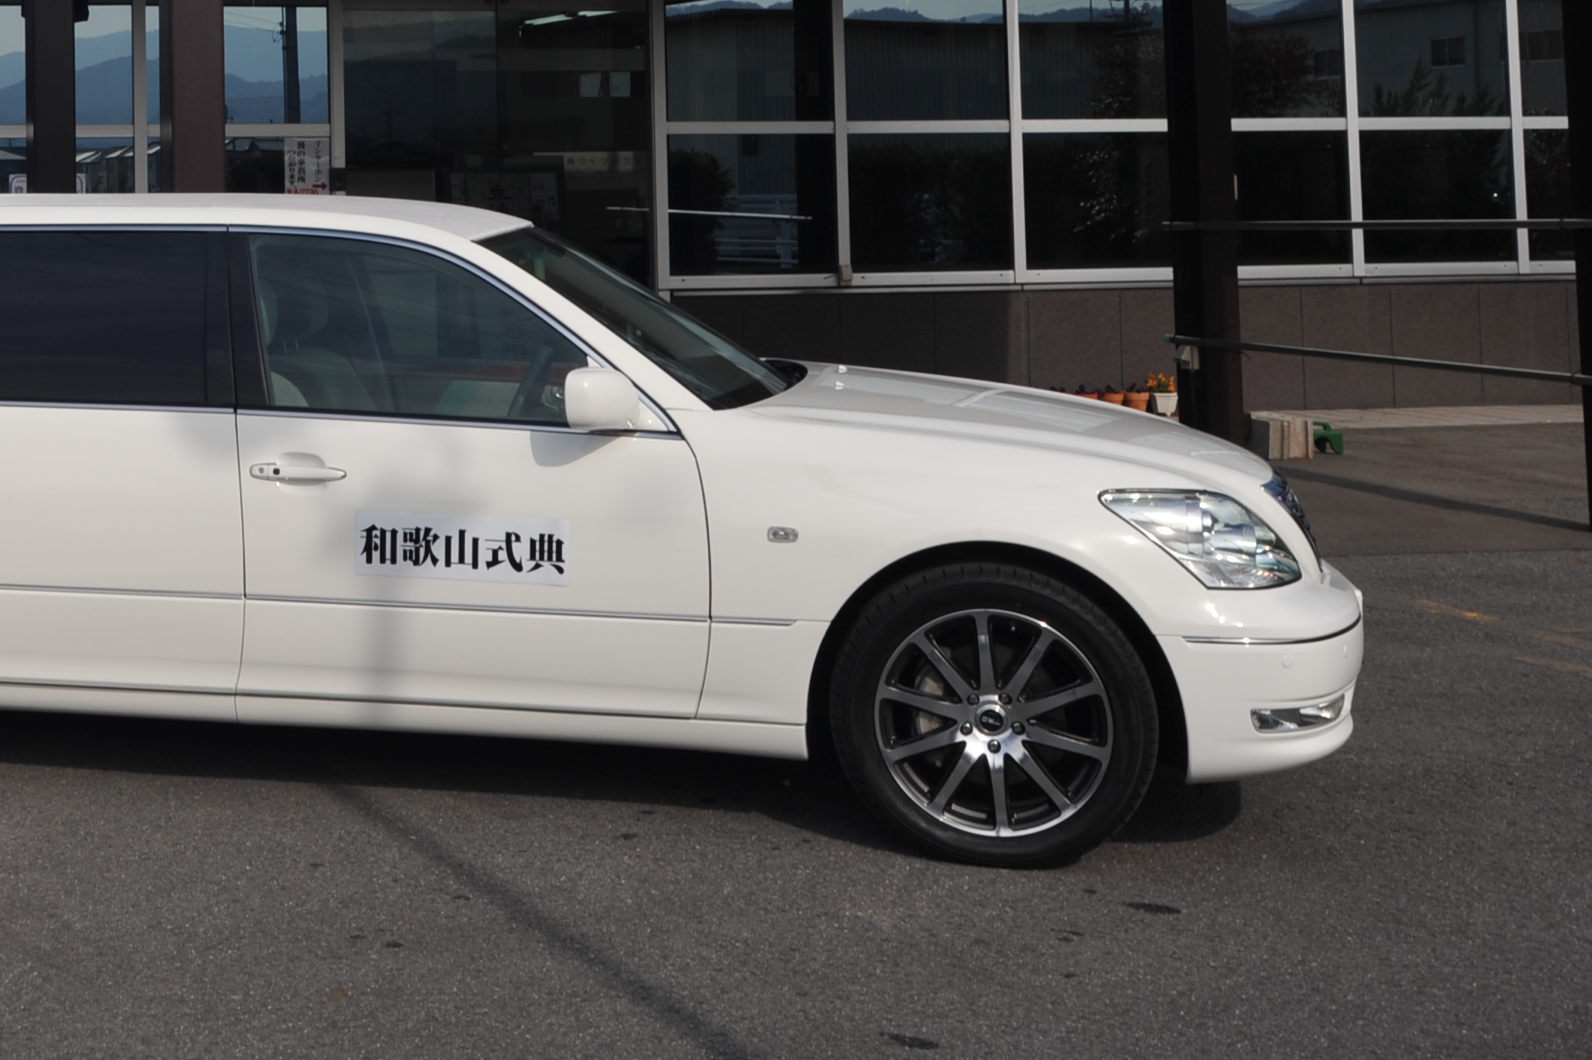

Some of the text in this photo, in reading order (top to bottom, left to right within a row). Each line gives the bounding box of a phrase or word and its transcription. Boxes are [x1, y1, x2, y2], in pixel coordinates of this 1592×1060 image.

[360, 524, 566, 575] 和歌山式典
